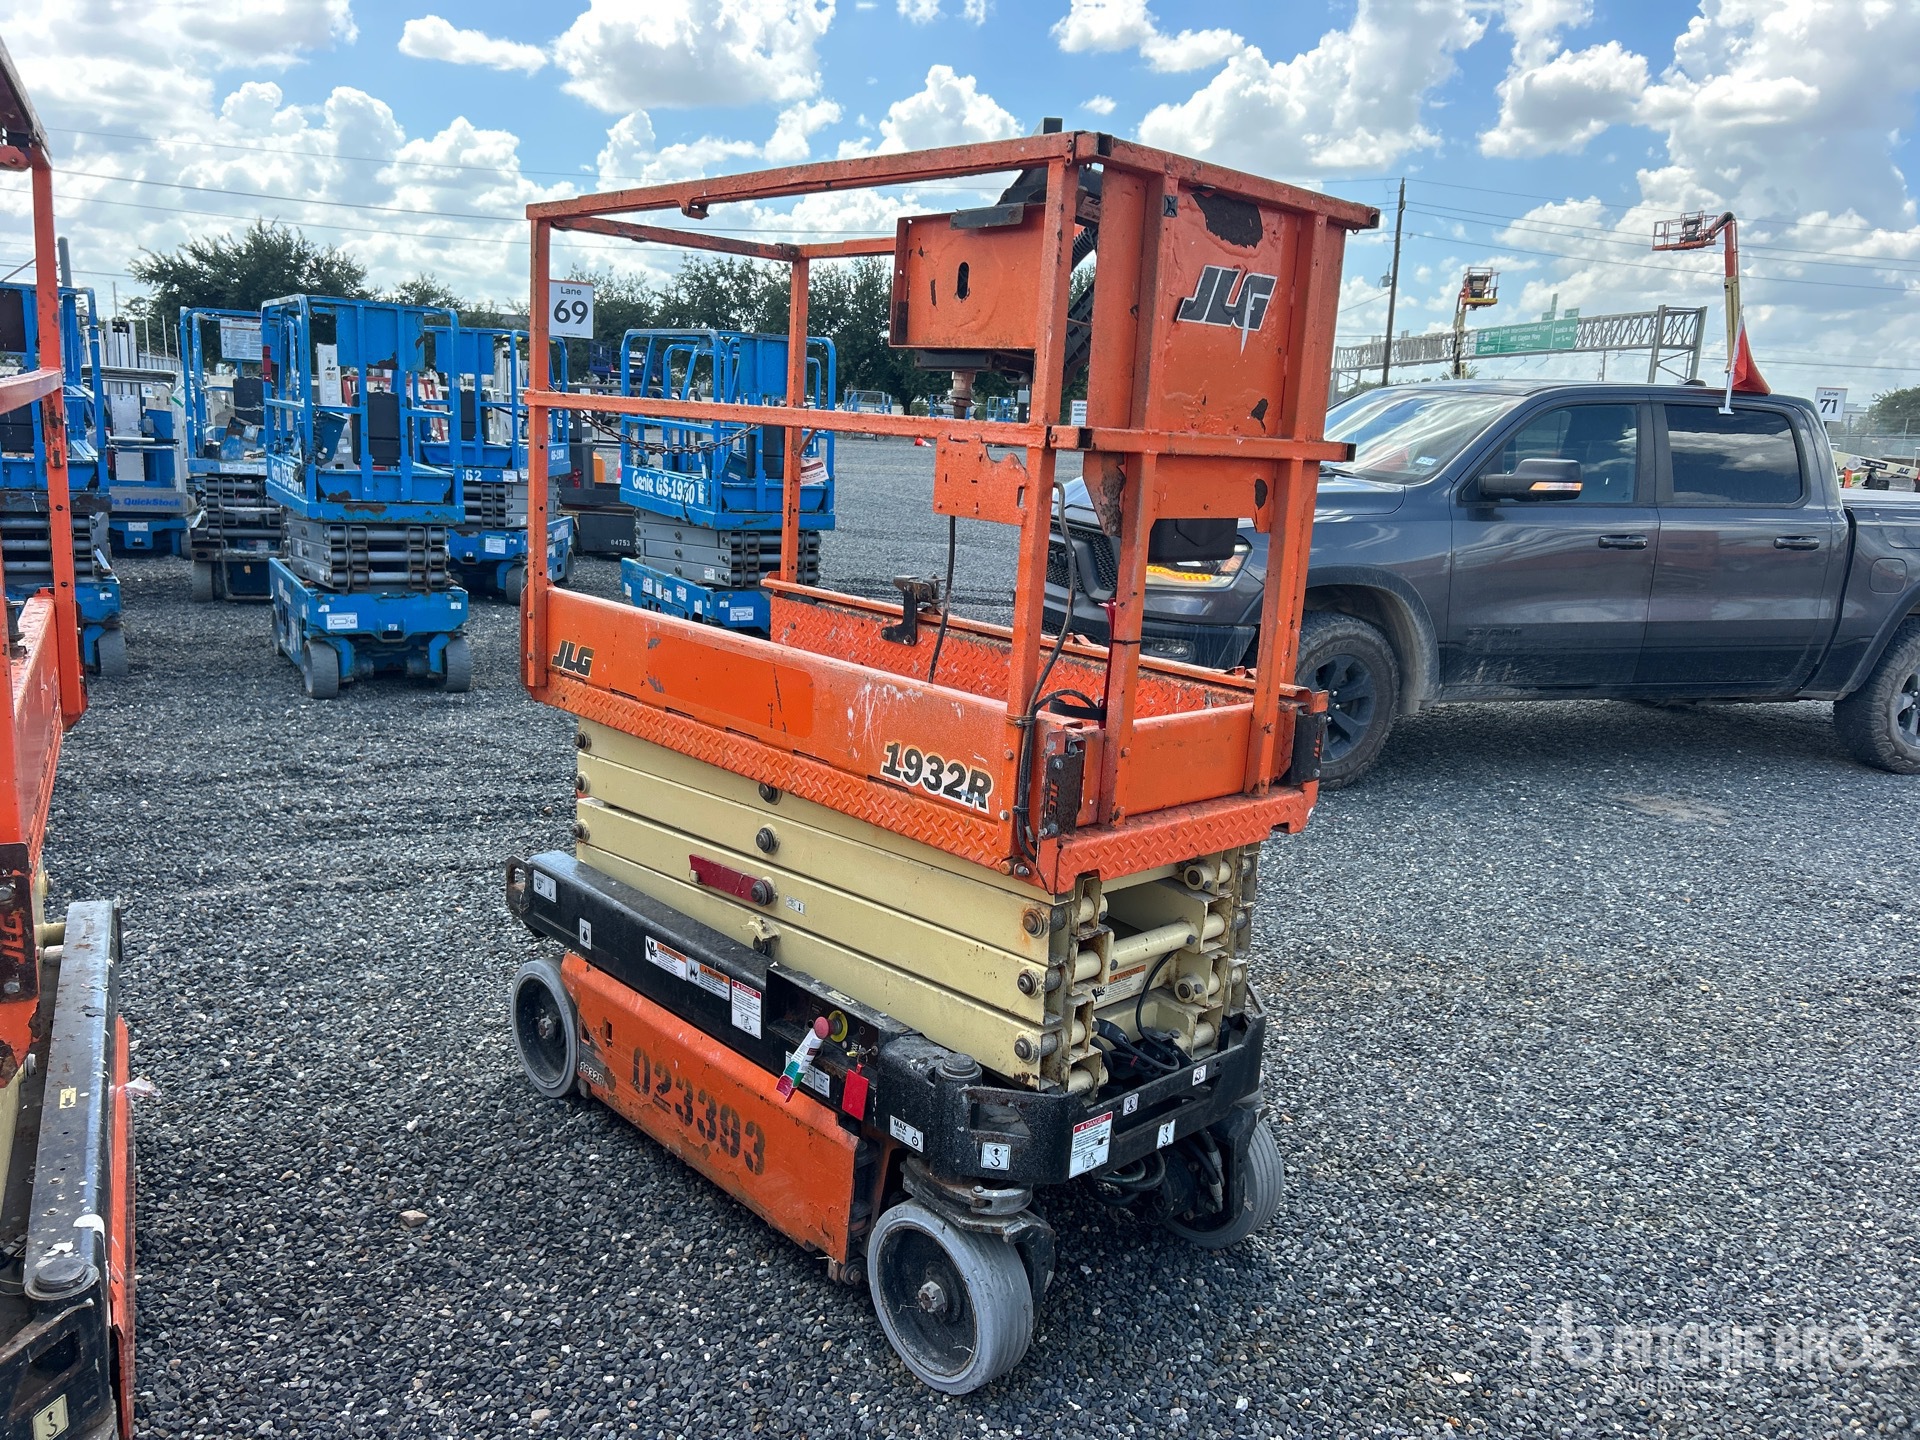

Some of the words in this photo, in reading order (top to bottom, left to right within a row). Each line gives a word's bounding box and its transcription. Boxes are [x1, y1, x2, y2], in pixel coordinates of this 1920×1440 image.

[560, 286, 582, 296] Lane
[1177, 265, 1277, 331] JLG
[553, 299, 589, 325] 69
[1819, 398, 1838, 414] 71
[632, 470, 654, 493] Genie
[656, 475, 696, 505] GS-1930
[551, 639, 595, 678] JLG
[879, 739, 994, 815] 1932R
[632, 1046, 766, 1176] 023393
